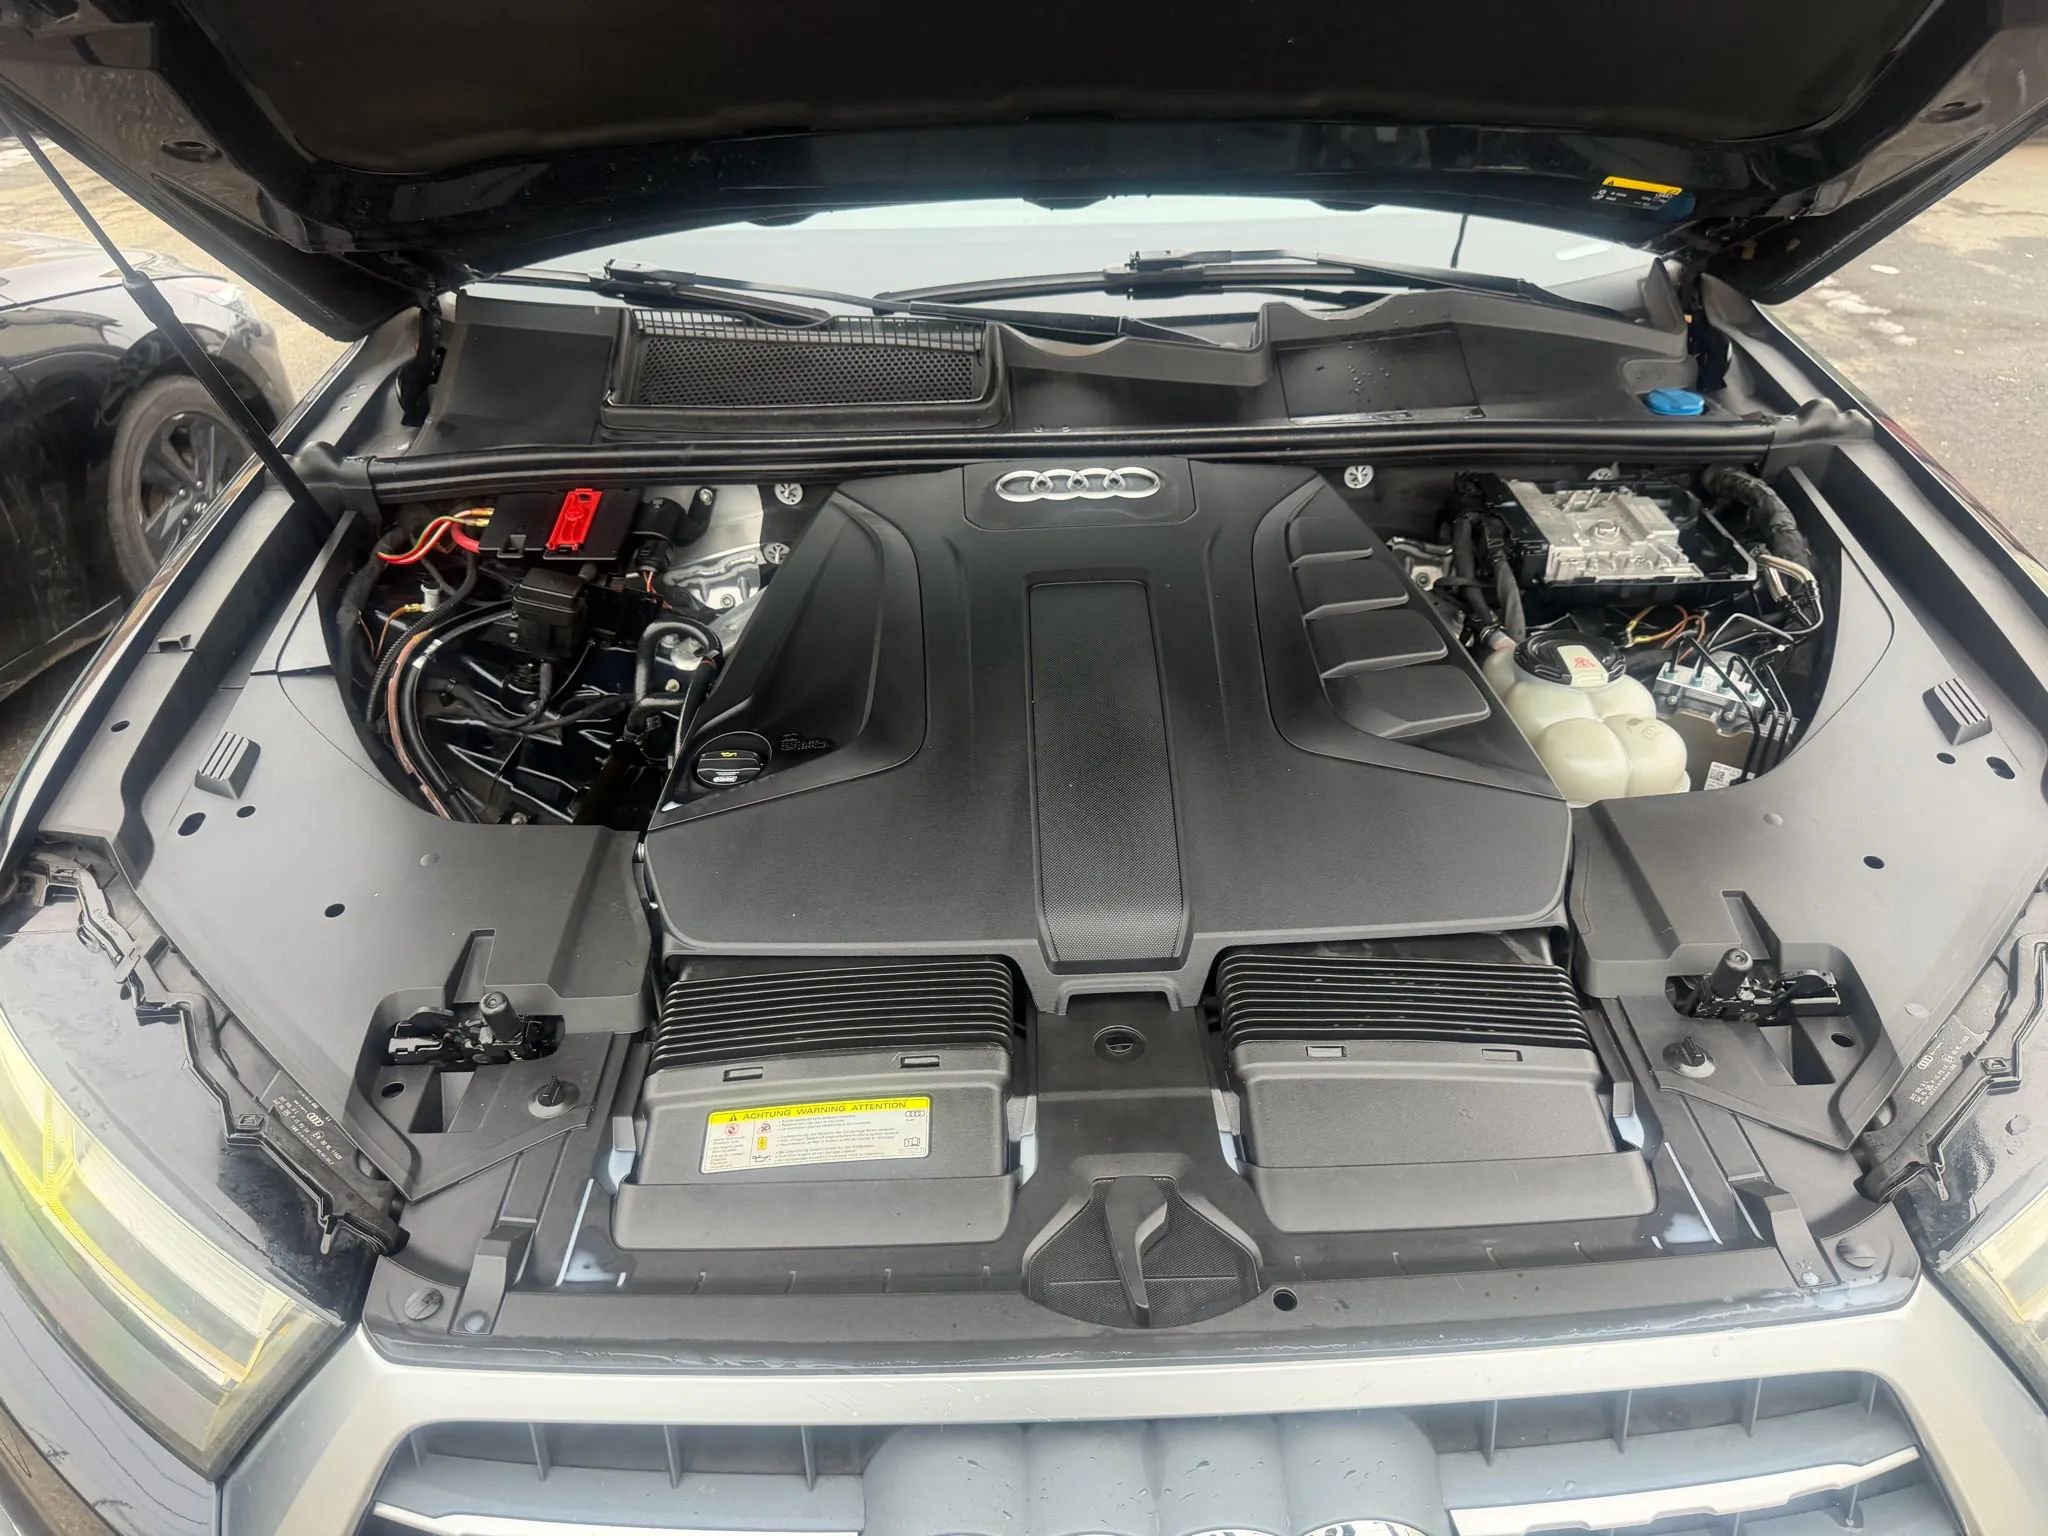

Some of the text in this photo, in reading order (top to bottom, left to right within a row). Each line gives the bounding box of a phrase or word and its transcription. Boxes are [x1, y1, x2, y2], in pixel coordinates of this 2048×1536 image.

[743, 1102, 906, 1120] ACHTUNG WARNING ATTENTION
